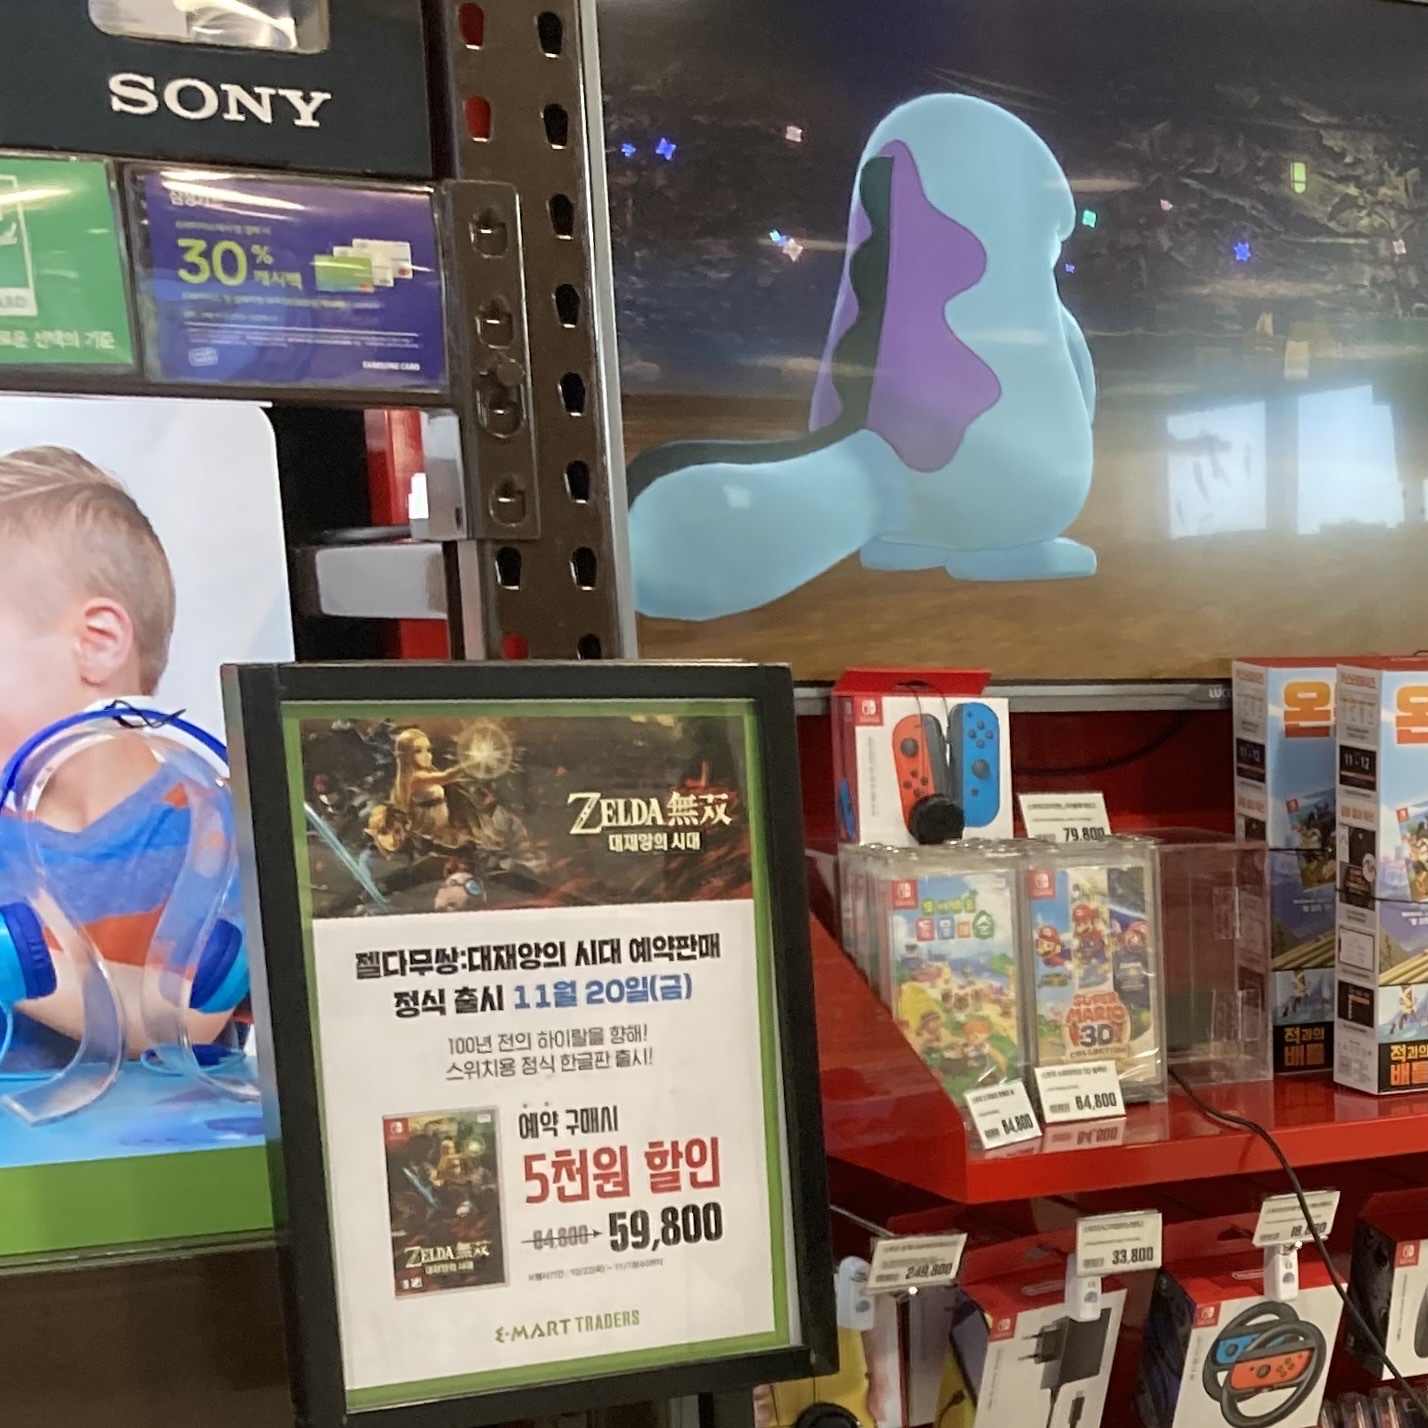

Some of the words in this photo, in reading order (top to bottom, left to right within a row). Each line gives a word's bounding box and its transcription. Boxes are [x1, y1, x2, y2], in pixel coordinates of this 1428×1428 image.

[108, 73, 332, 128] SONY
[567, 792, 664, 834] ZELDA
[609, 832, 668, 852] 대재앙의
[670, 831, 701, 851] 시대
[575, 937, 623, 967] 시대
[628, 932, 721, 964] 예약판매
[393, 988, 447, 1019] 정식
[454, 984, 505, 1014] 출시
[513, 979, 578, 1010] 11월
[585, 972, 693, 1005] 20일(금)
[1065, 1005, 1127, 1025] MARIO
[447, 1032, 493, 1056] 100년
[497, 1031, 532, 1052] 전의
[537, 1027, 605, 1051] 하이랄을
[608, 1024, 648, 1044] 향해!
[1079, 1023, 1115, 1048] 3D
[445, 1059, 517, 1081] 스위치용
[520, 1056, 556, 1076] 정식
[559, 1050, 612, 1073] 한글판
[614, 1047, 654, 1069] 출시!
[518, 1110, 560, 1140] 예약
[565, 1105, 620, 1134] 구매시
[523, 1145, 631, 1204] 5천원
[643, 1136, 722, 1194] 할인
[608, 1201, 724, 1252] 59,800
[403, 1245, 456, 1269] ZELDA
[1111, 1247, 1155, 1266] 33,800
[574, 1309, 641, 1333] TRADERS
